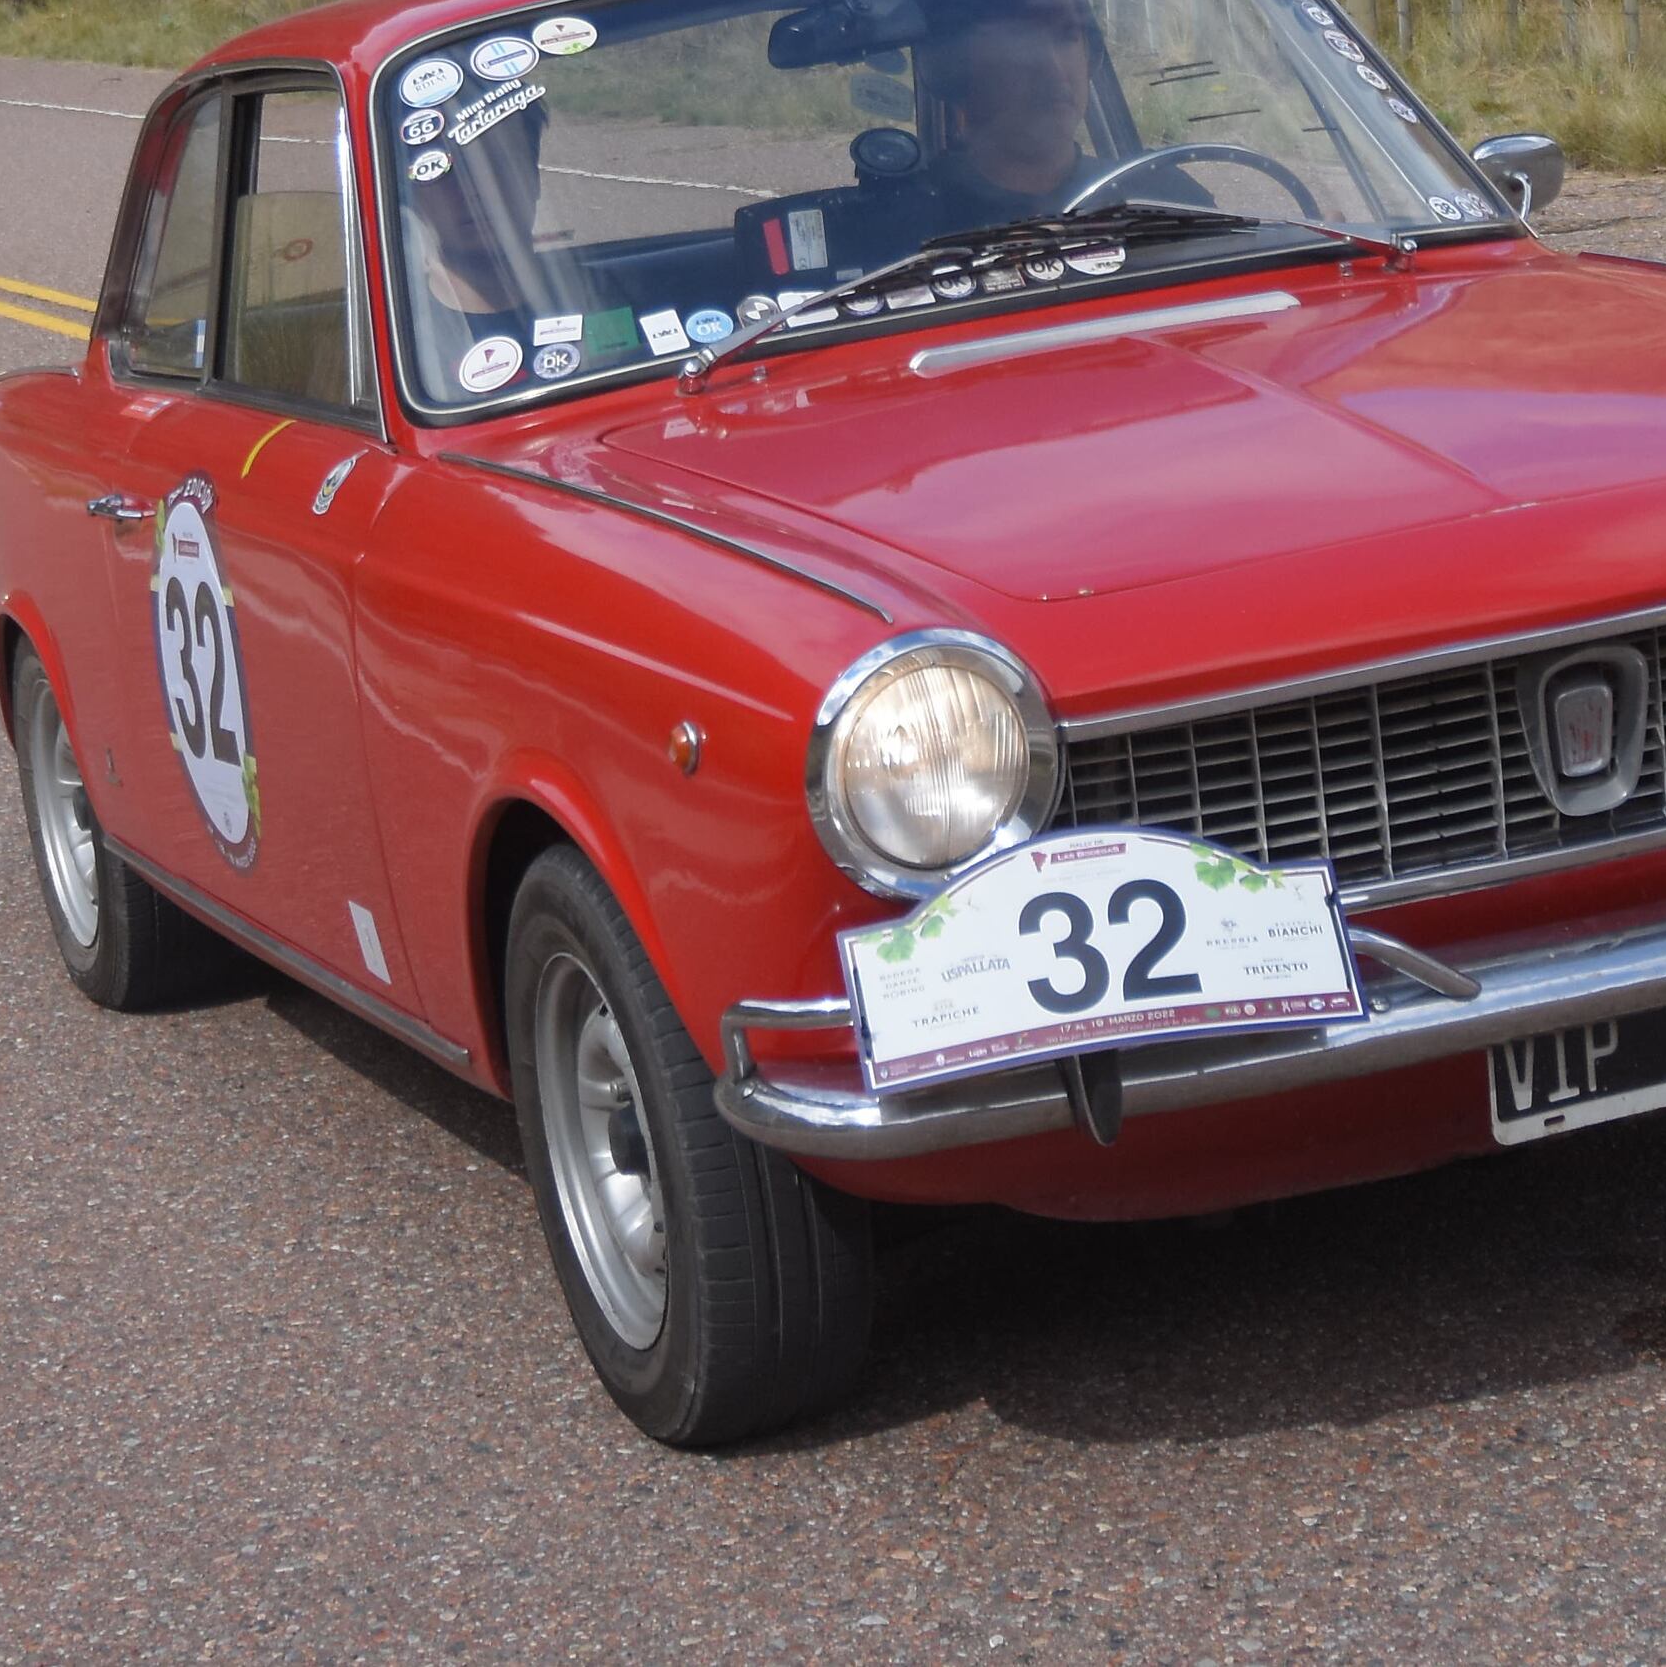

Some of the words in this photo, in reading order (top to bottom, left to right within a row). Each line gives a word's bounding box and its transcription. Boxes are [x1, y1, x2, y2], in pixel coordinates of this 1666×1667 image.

[455, 100, 486, 123] Mini
[484, 79, 522, 104] Rally
[447, 85, 547, 146] Tartaruga
[408, 119, 435, 138] 66
[416, 160, 445, 176] OK
[1034, 258, 1060, 274] OK
[697, 322, 722, 337] OK
[543, 351, 569, 370] OK
[165, 576, 242, 767] 32
[1267, 925, 1324, 939] BIANCHI
[1018, 878, 1204, 1015] 32
[940, 957, 1012, 983] USPALLATA
[1244, 962, 1309, 976] TRIVENTO
[911, 1006, 982, 1028] TRAPICHE
[1109, 1013, 1145, 1026] MARZO
[1502, 1019, 1618, 1112] VIP
